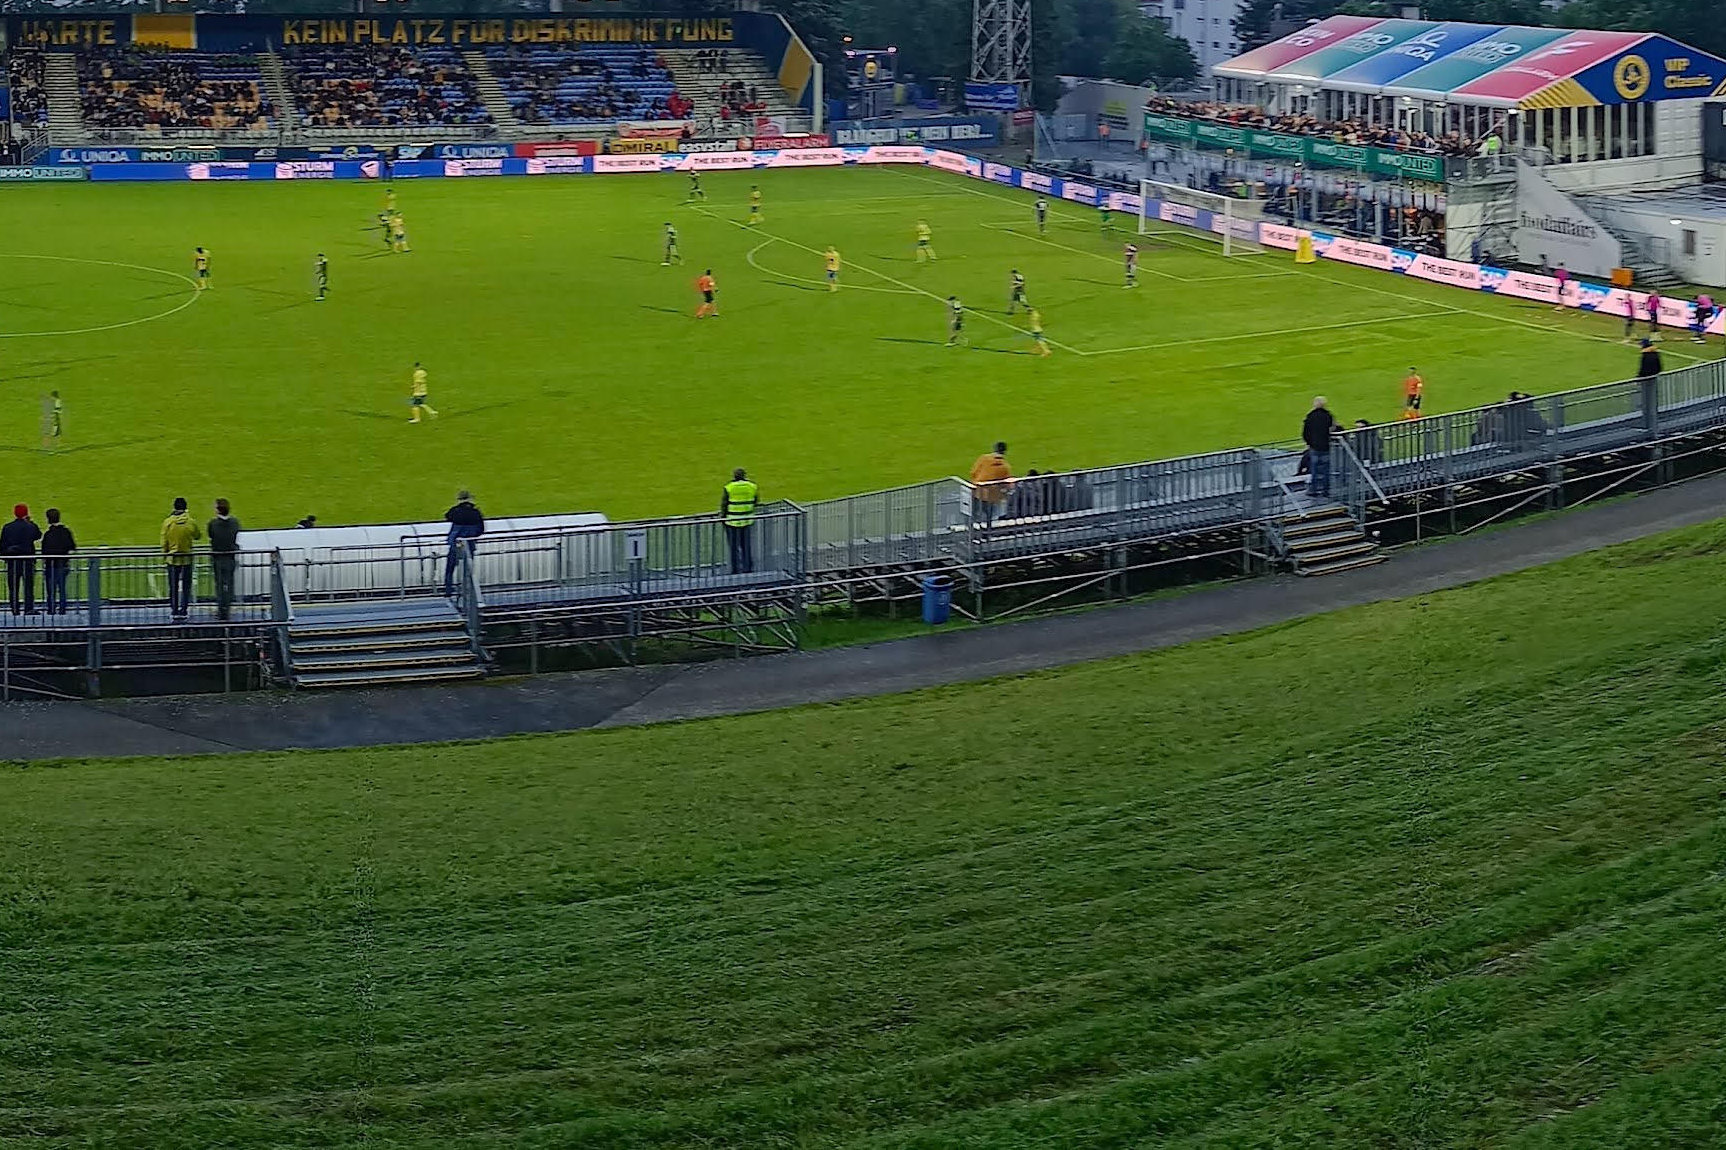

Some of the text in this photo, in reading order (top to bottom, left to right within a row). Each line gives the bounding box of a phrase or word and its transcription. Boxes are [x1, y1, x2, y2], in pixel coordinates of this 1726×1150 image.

[283, 20, 347, 44] KEIN
[353, 18, 445, 44] PLATZ
[81, 150, 130, 162] UNIQA
[141, 151, 173, 161] IMMO
[462, 147, 509, 159] UNIQA
[0, 167, 32, 179] IMMO
[1422, 261, 1437, 274] THE
[1438, 264, 1457, 278] BEST
